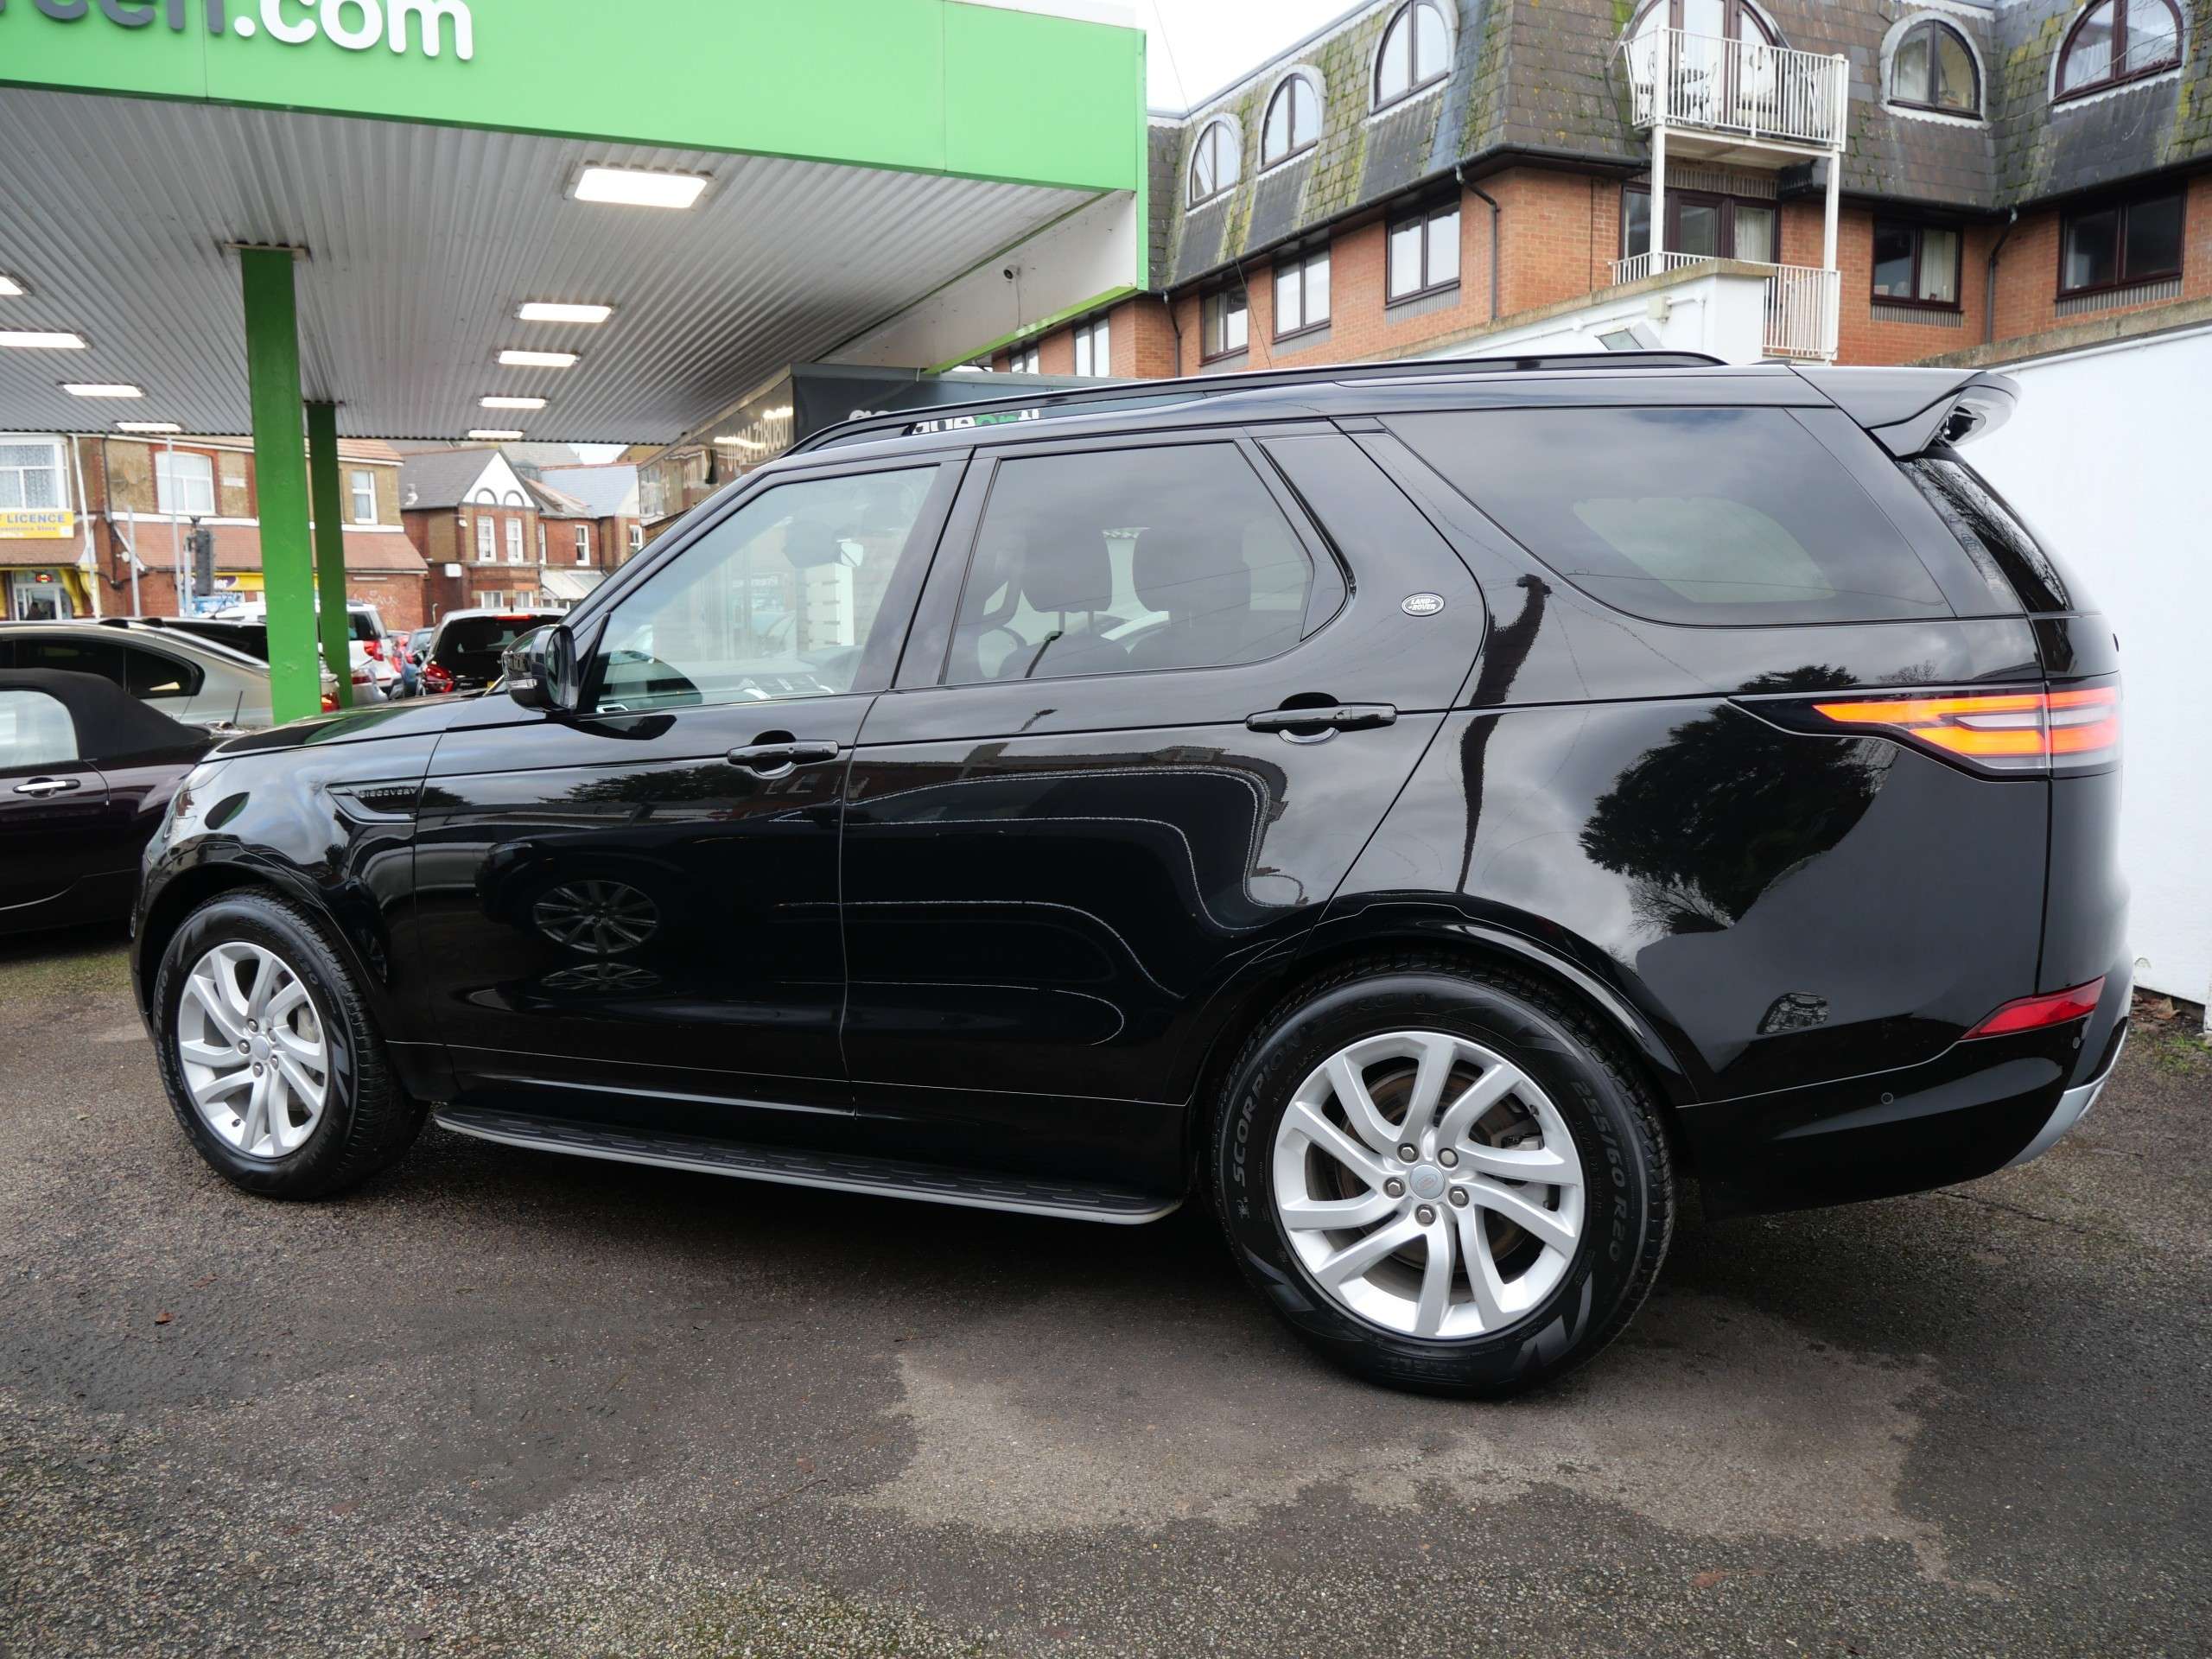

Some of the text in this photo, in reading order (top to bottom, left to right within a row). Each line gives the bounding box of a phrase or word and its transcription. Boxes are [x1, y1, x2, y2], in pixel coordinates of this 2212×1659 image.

[7, 513, 64, 524] LICENCE
[359, 787, 417, 798] DISCOVERY
[1569, 1080, 1625, 1188] 255/60
[1608, 1193, 1629, 1262] R20
